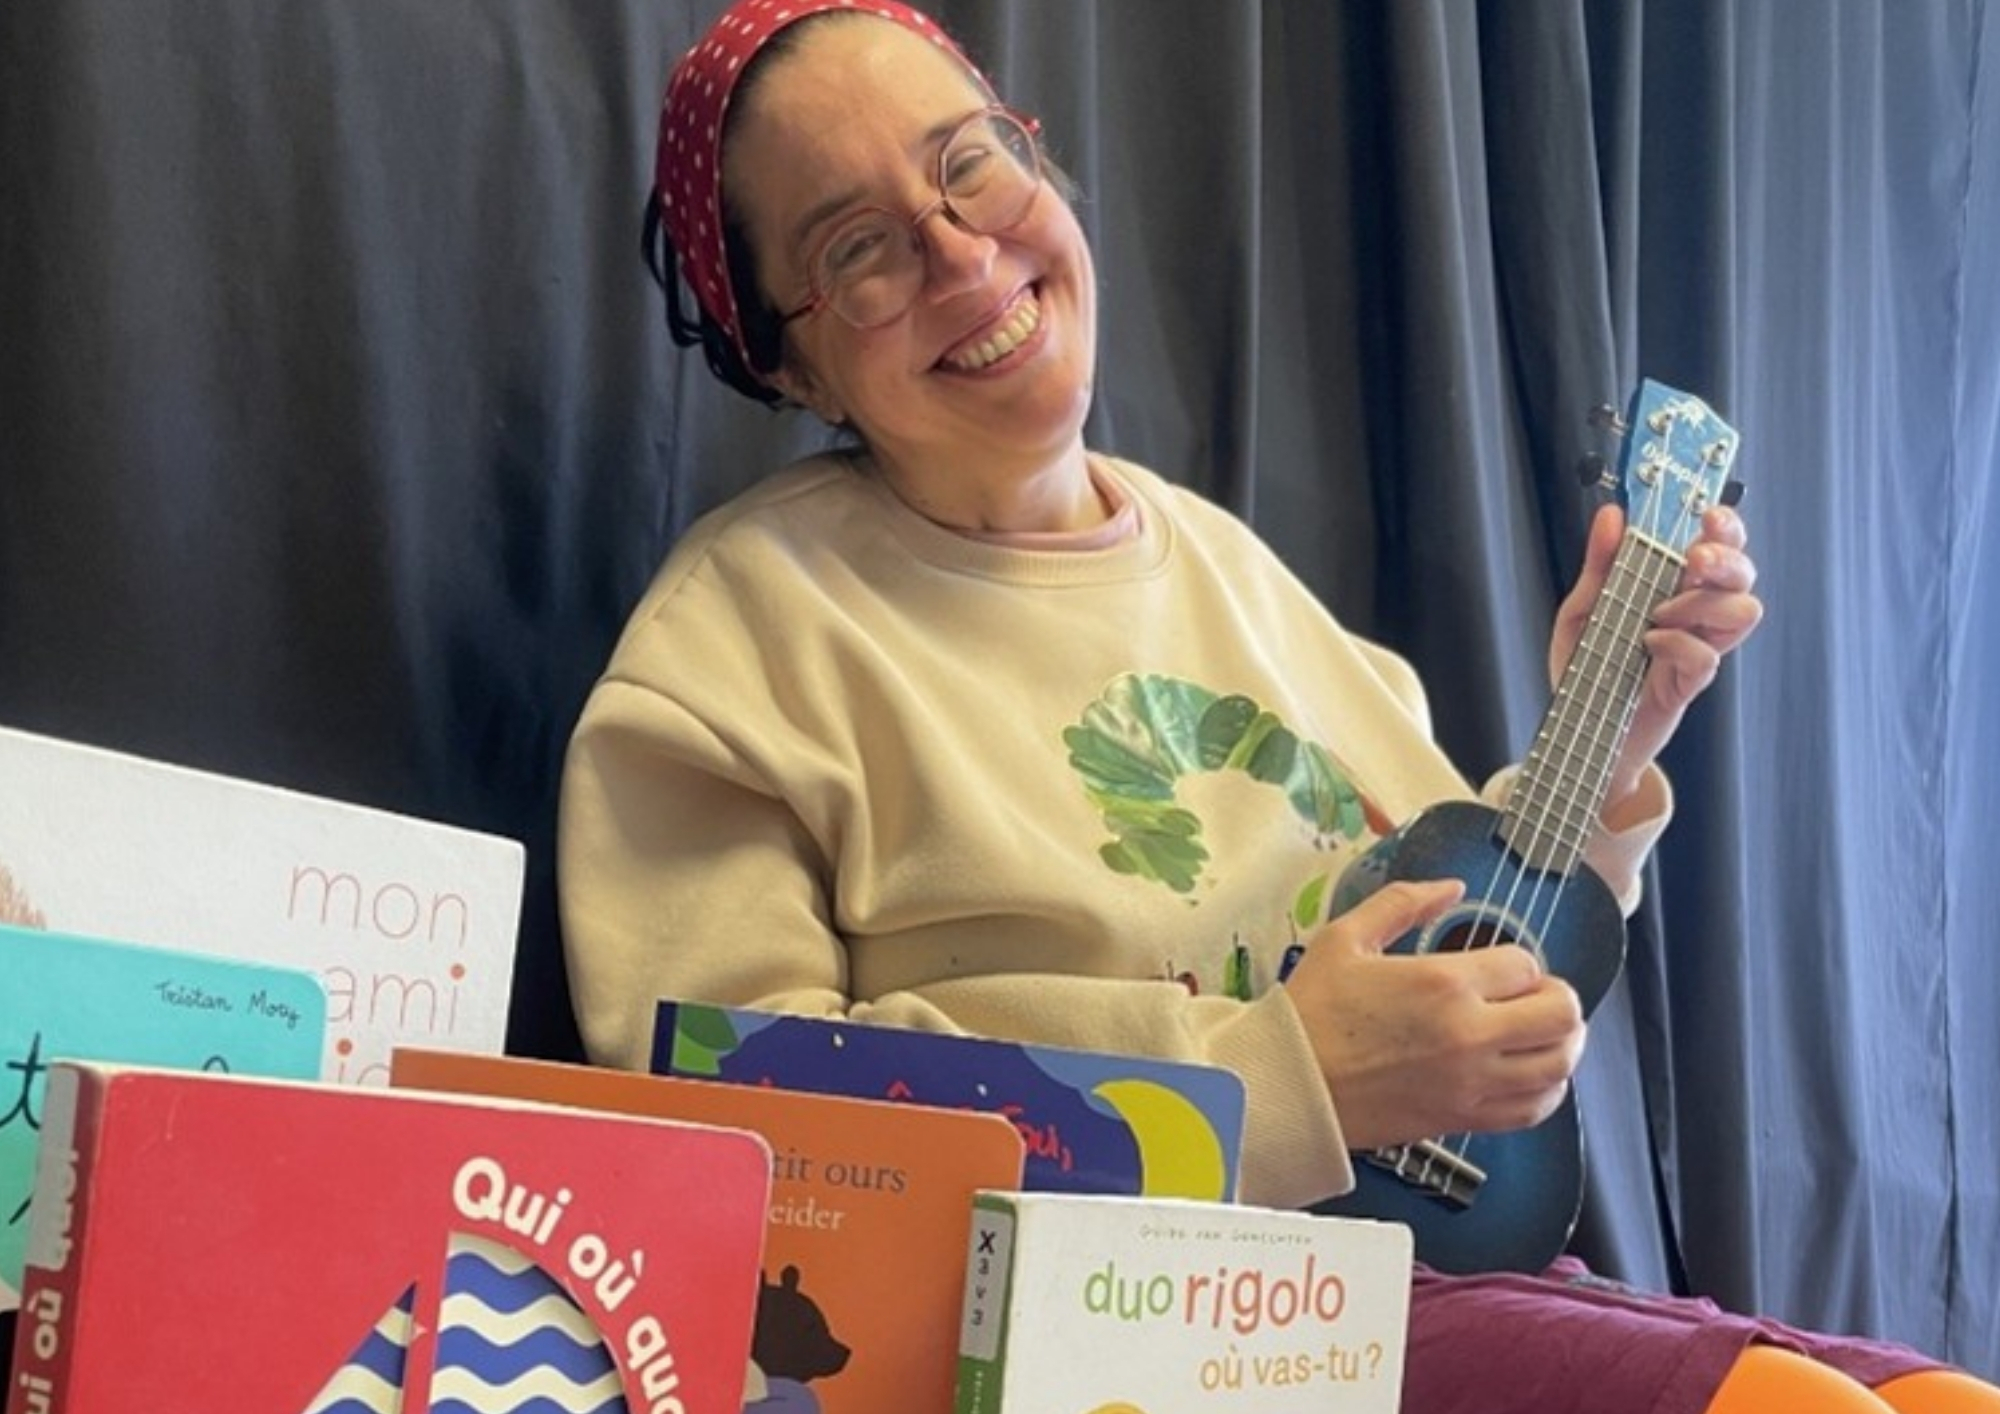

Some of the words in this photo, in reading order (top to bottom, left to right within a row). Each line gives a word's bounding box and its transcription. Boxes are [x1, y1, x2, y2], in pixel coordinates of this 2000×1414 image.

[288, 866, 467, 947] mon
[155, 980, 233, 1012] Tristan
[325, 963, 466, 1035] ami
[772, 1147, 813, 1181] tit
[825, 1161, 908, 1194] ours
[452, 1156, 573, 1246] Qui
[568, 1233, 644, 1312] où
[768, 1197, 846, 1231] eider
[977, 1230, 996, 1254] X
[1084, 1261, 1174, 1321] duo
[1183, 1253, 1346, 1335] rigolo
[27, 1288, 64, 1360] où
[1200, 1344, 1243, 1391] où
